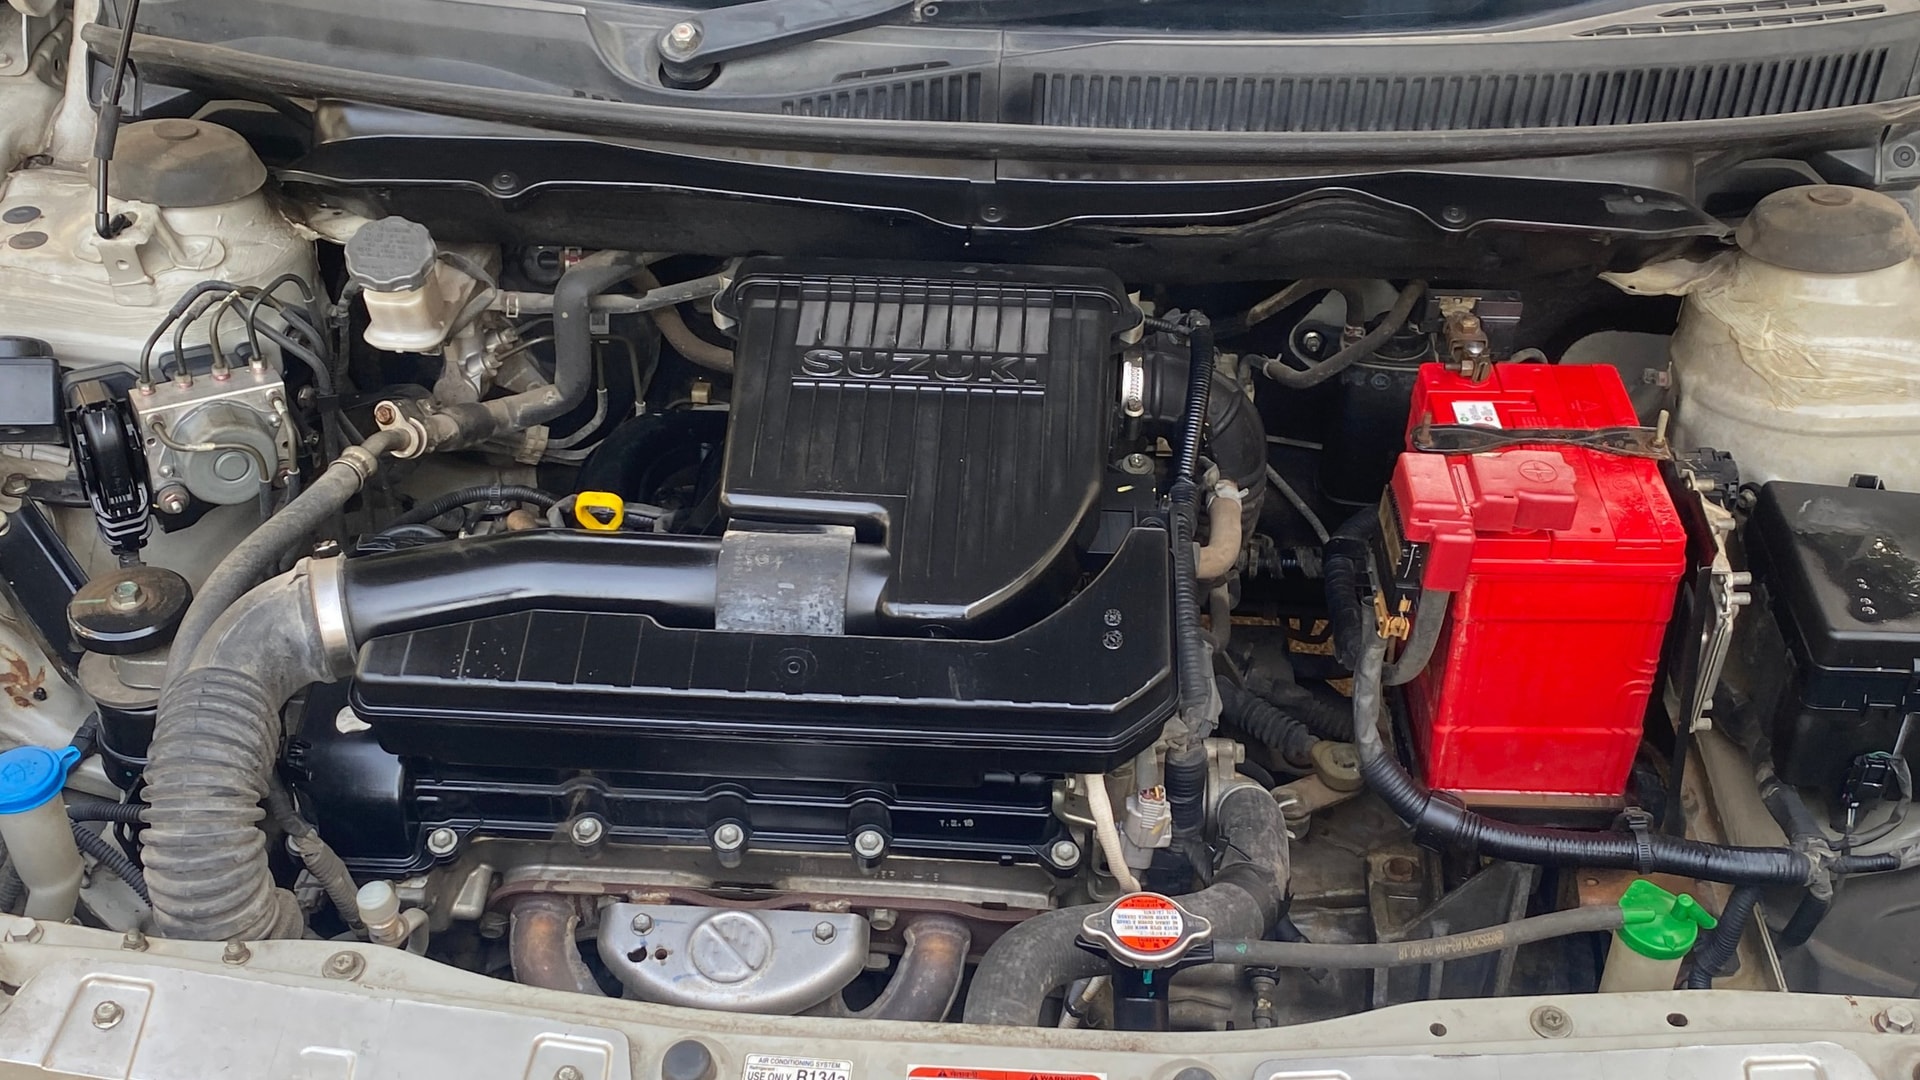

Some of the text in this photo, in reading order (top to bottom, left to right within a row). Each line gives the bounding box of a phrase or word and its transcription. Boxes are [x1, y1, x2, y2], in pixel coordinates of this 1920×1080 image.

[801, 350, 1038, 384] SUZUKI
[770, 1059, 814, 1067] CONDITIONING
[747, 1071, 766, 1080] USE
